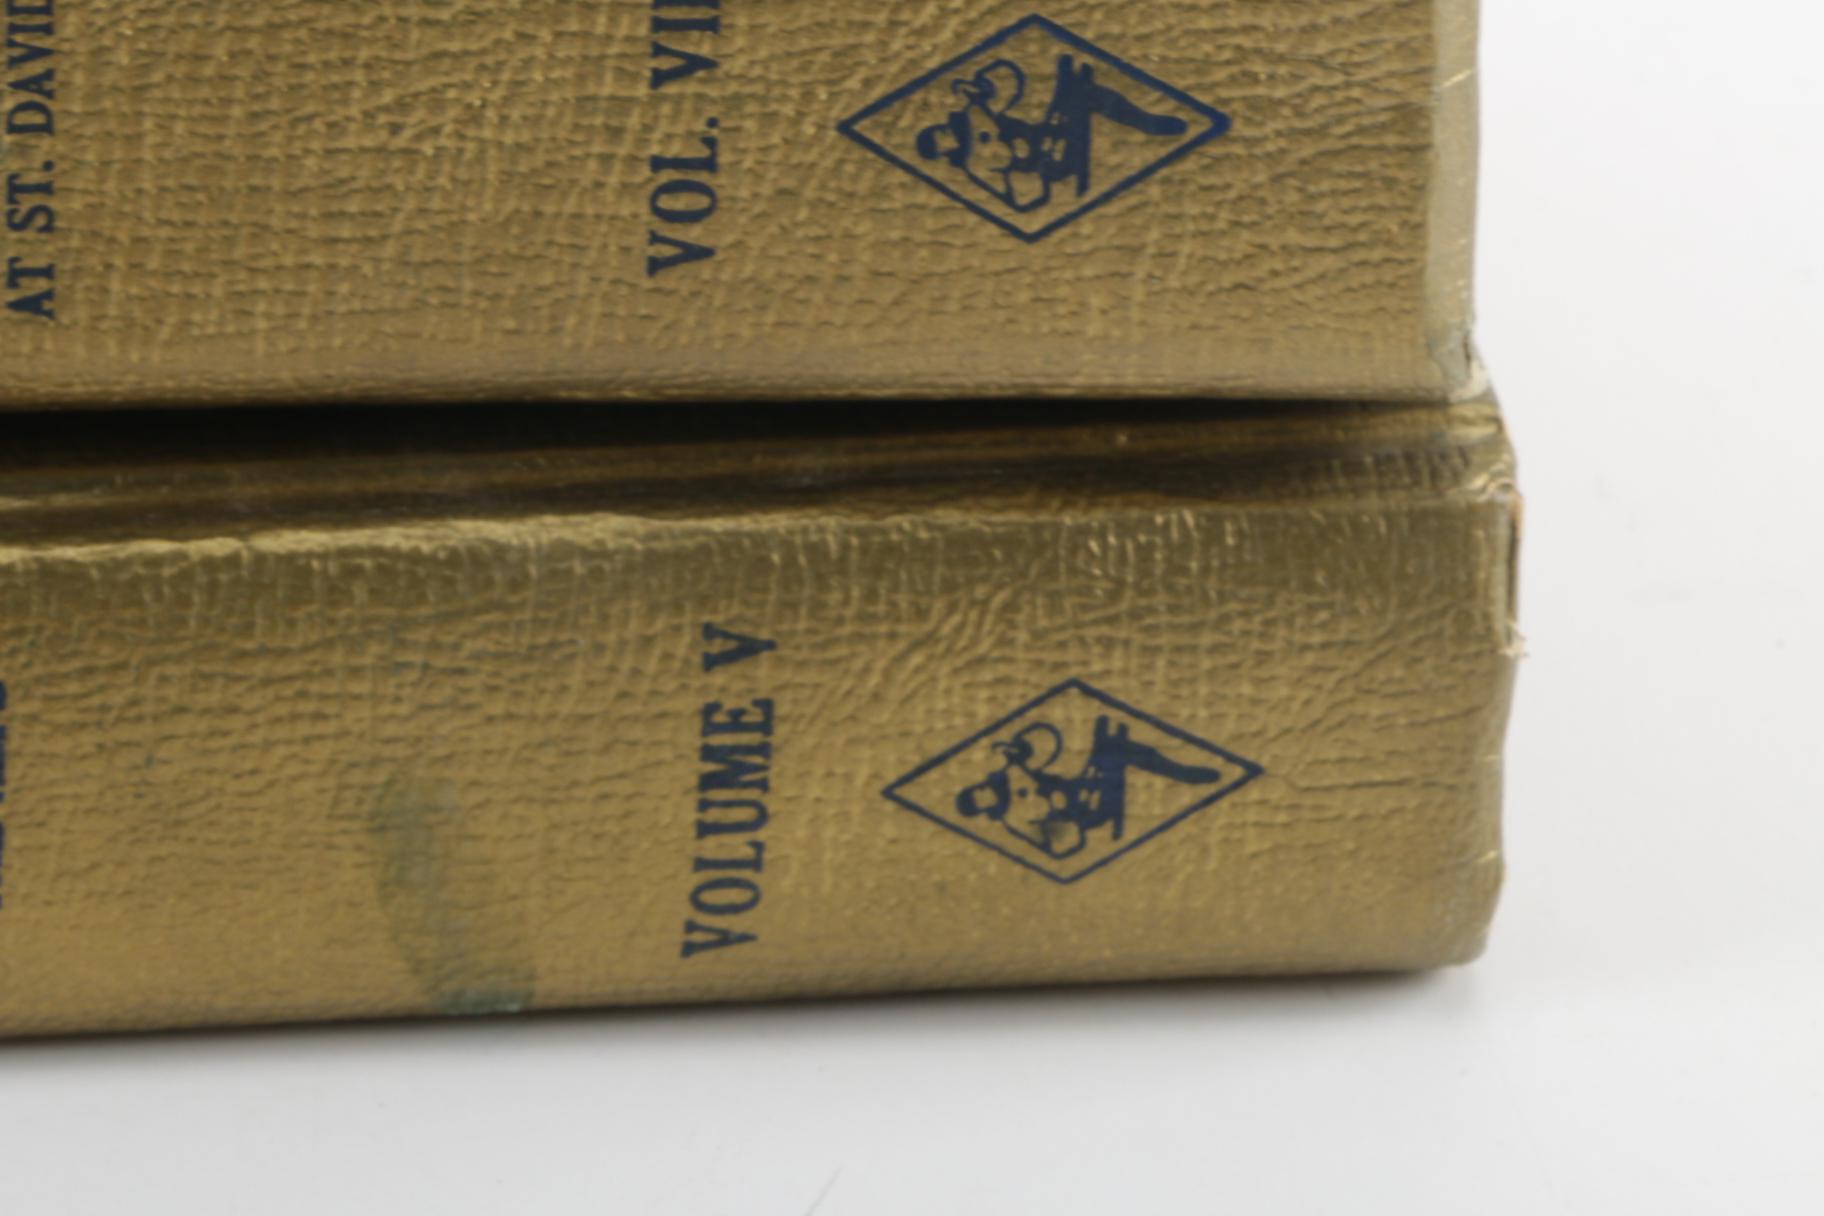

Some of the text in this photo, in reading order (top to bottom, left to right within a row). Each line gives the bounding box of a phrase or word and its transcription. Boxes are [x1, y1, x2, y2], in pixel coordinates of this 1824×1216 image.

[6, 159, 55, 234] ST.
[646, 116, 720, 276] VOL.
[6, 255, 56, 320] AT
[681, 622, 776, 958] VOLUME V
